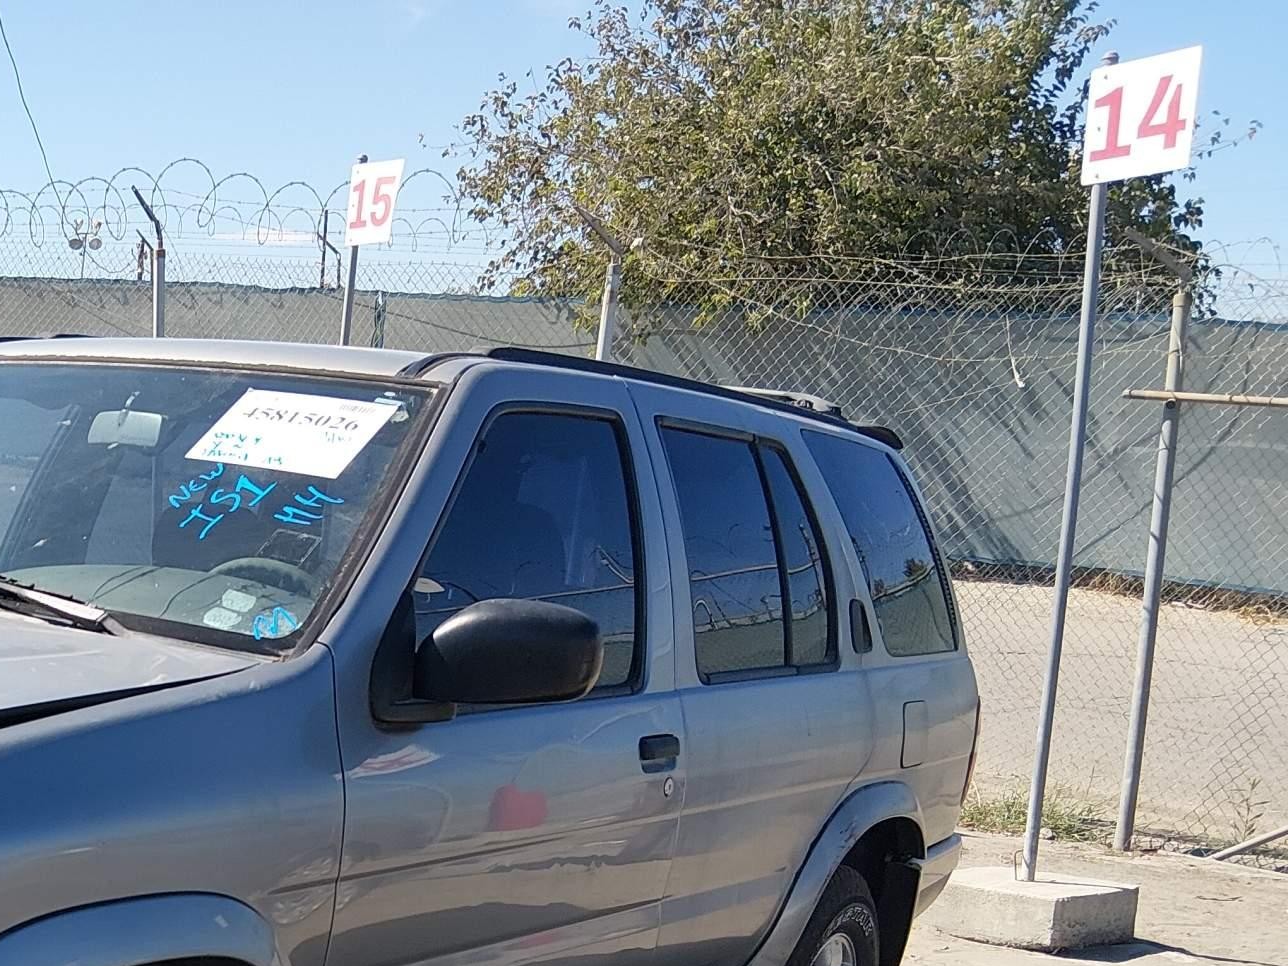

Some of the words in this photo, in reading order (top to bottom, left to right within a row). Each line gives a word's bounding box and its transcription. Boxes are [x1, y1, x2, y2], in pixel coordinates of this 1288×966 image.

[1089, 74, 1187, 162] 14
[349, 175, 397, 229] 15
[242, 406, 360, 432] 45815026
